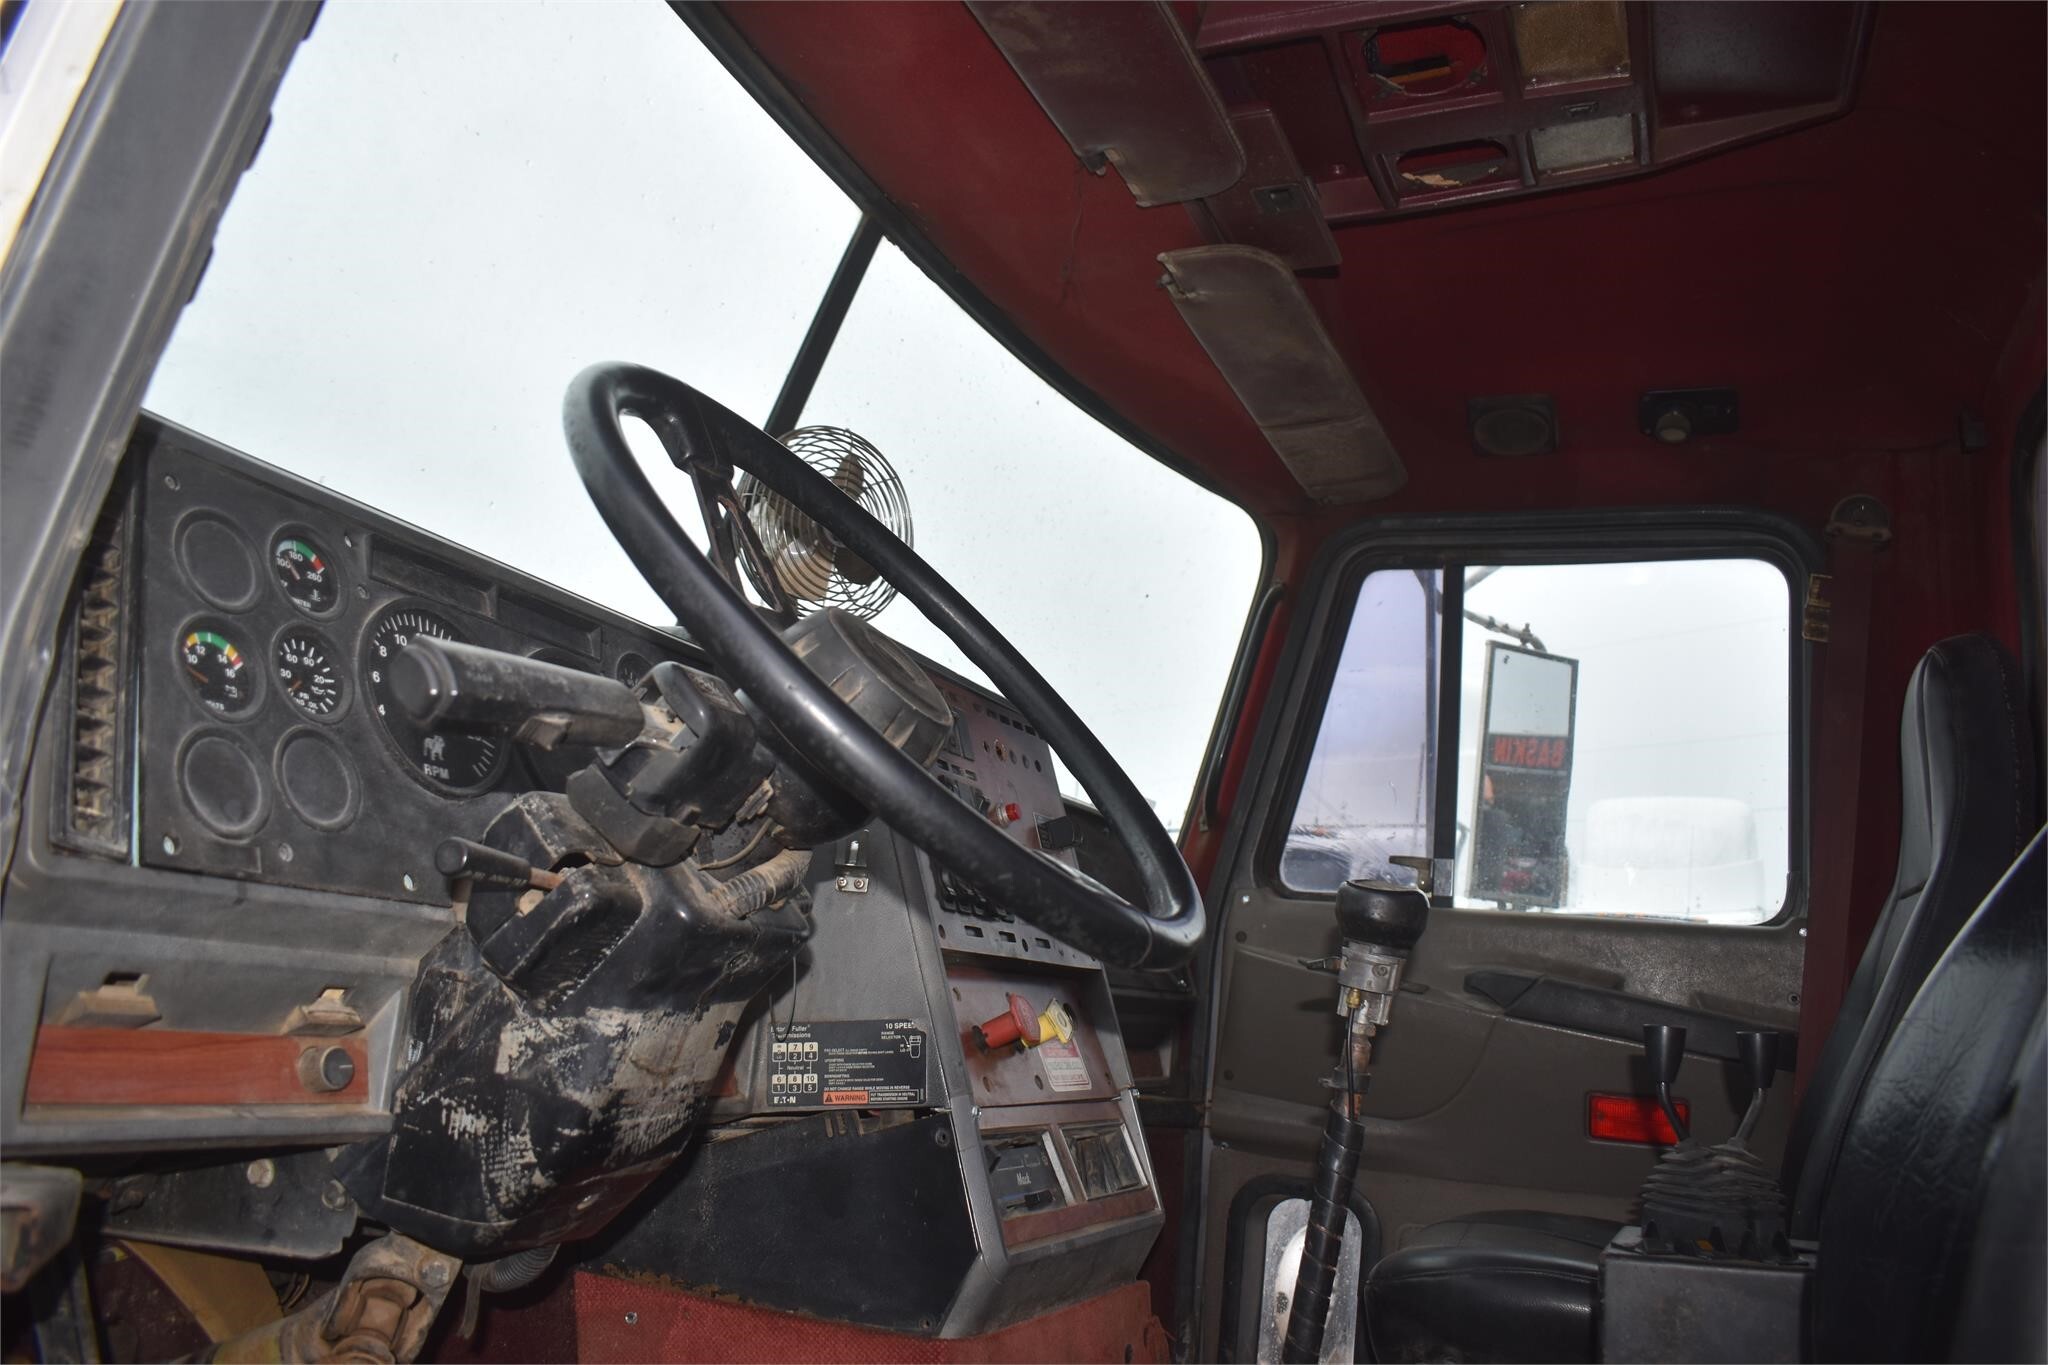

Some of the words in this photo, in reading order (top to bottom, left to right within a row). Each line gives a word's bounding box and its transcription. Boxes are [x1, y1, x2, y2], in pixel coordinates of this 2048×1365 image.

[288, 550, 303, 562] 180
[276, 557, 291, 568] 100
[394, 634, 407, 647] 10
[195, 645, 206, 656] 12
[379, 645, 388, 657] 8
[187, 654, 198, 665] 10
[217, 653, 228, 665] 14
[286, 653, 298, 664] 60
[303, 656, 315, 667] 90
[225, 668, 236, 678] 16
[280, 668, 292, 679] 30
[372, 671, 381, 683] 6
[378, 704, 386, 716] 4
[423, 763, 450, 780] RPM
[894, 1022, 914, 1030] SPEE
[808, 1043, 814, 1051] 9
[776, 1075, 782, 1083] 6
